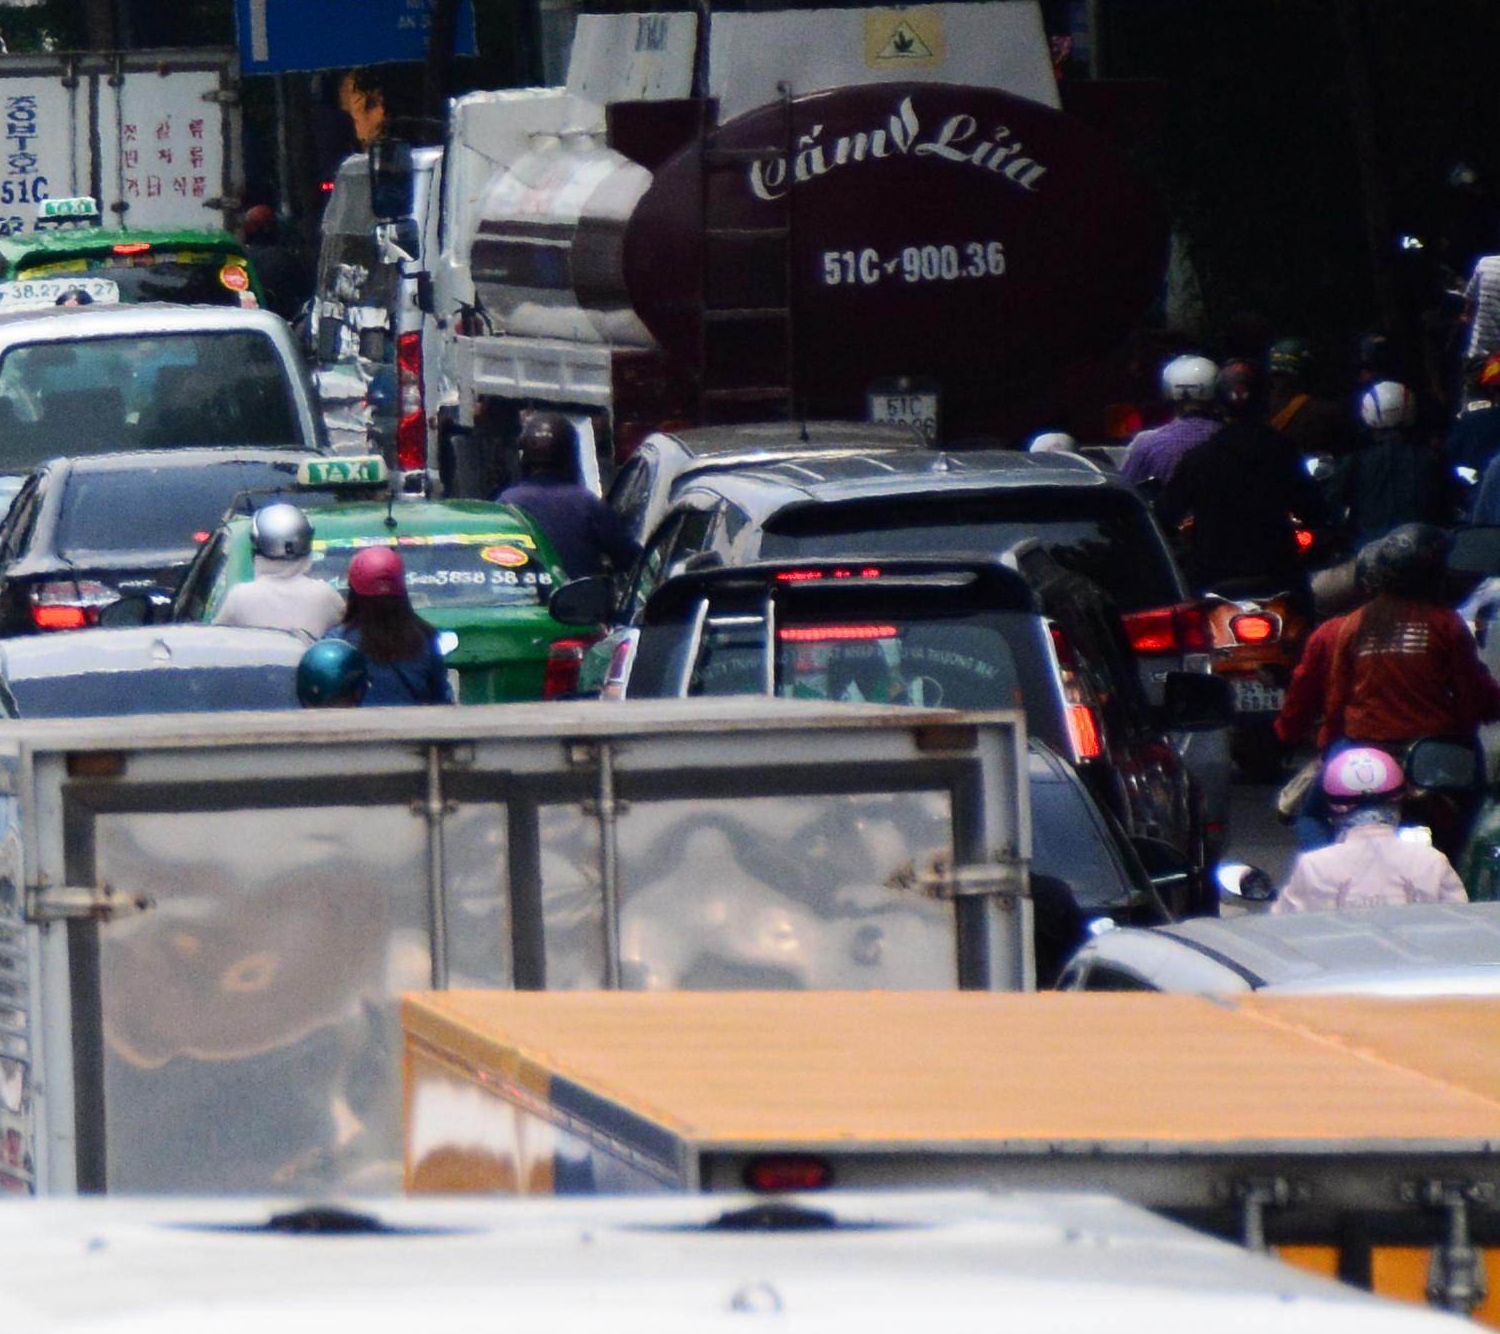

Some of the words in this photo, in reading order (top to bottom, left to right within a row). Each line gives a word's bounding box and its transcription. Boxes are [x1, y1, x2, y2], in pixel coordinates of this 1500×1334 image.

[749, 124, 892, 201] Cấm
[915, 113, 1048, 193] Lửa
[0, 176, 49, 205] 51C
[306, 461, 360, 481] TAXI
